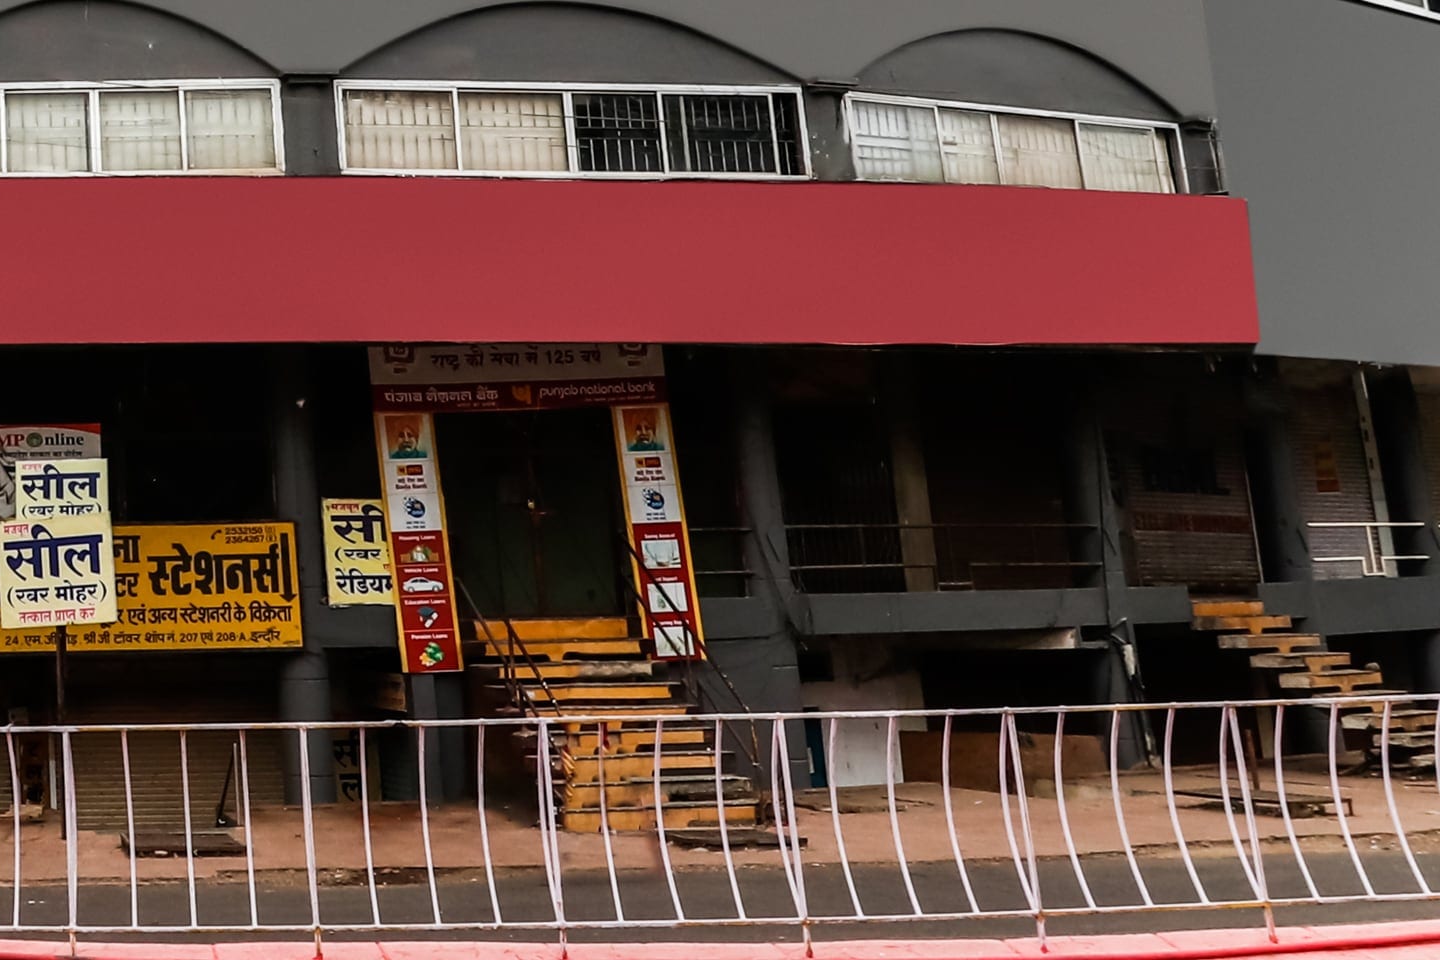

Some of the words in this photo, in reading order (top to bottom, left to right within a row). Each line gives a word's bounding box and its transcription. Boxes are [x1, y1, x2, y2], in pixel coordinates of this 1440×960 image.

[464, 347, 483, 366] की
[546, 350, 574, 364] 125
[540, 387, 577, 399] punjab
[580, 384, 624, 396] national
[628, 382, 655, 394] bank
[21, 464, 100, 501] सील
[331, 504, 386, 544] सी
[3, 524, 103, 581] सील
[147, 543, 280, 595] स्टेशनर्स
[148, 607, 178, 625] अन्य
[180, 602, 231, 625] स्टेशनरी
[233, 602, 247, 622] के
[248, 600, 292, 622] विक्रेता
[180, 633, 198, 643] 207
